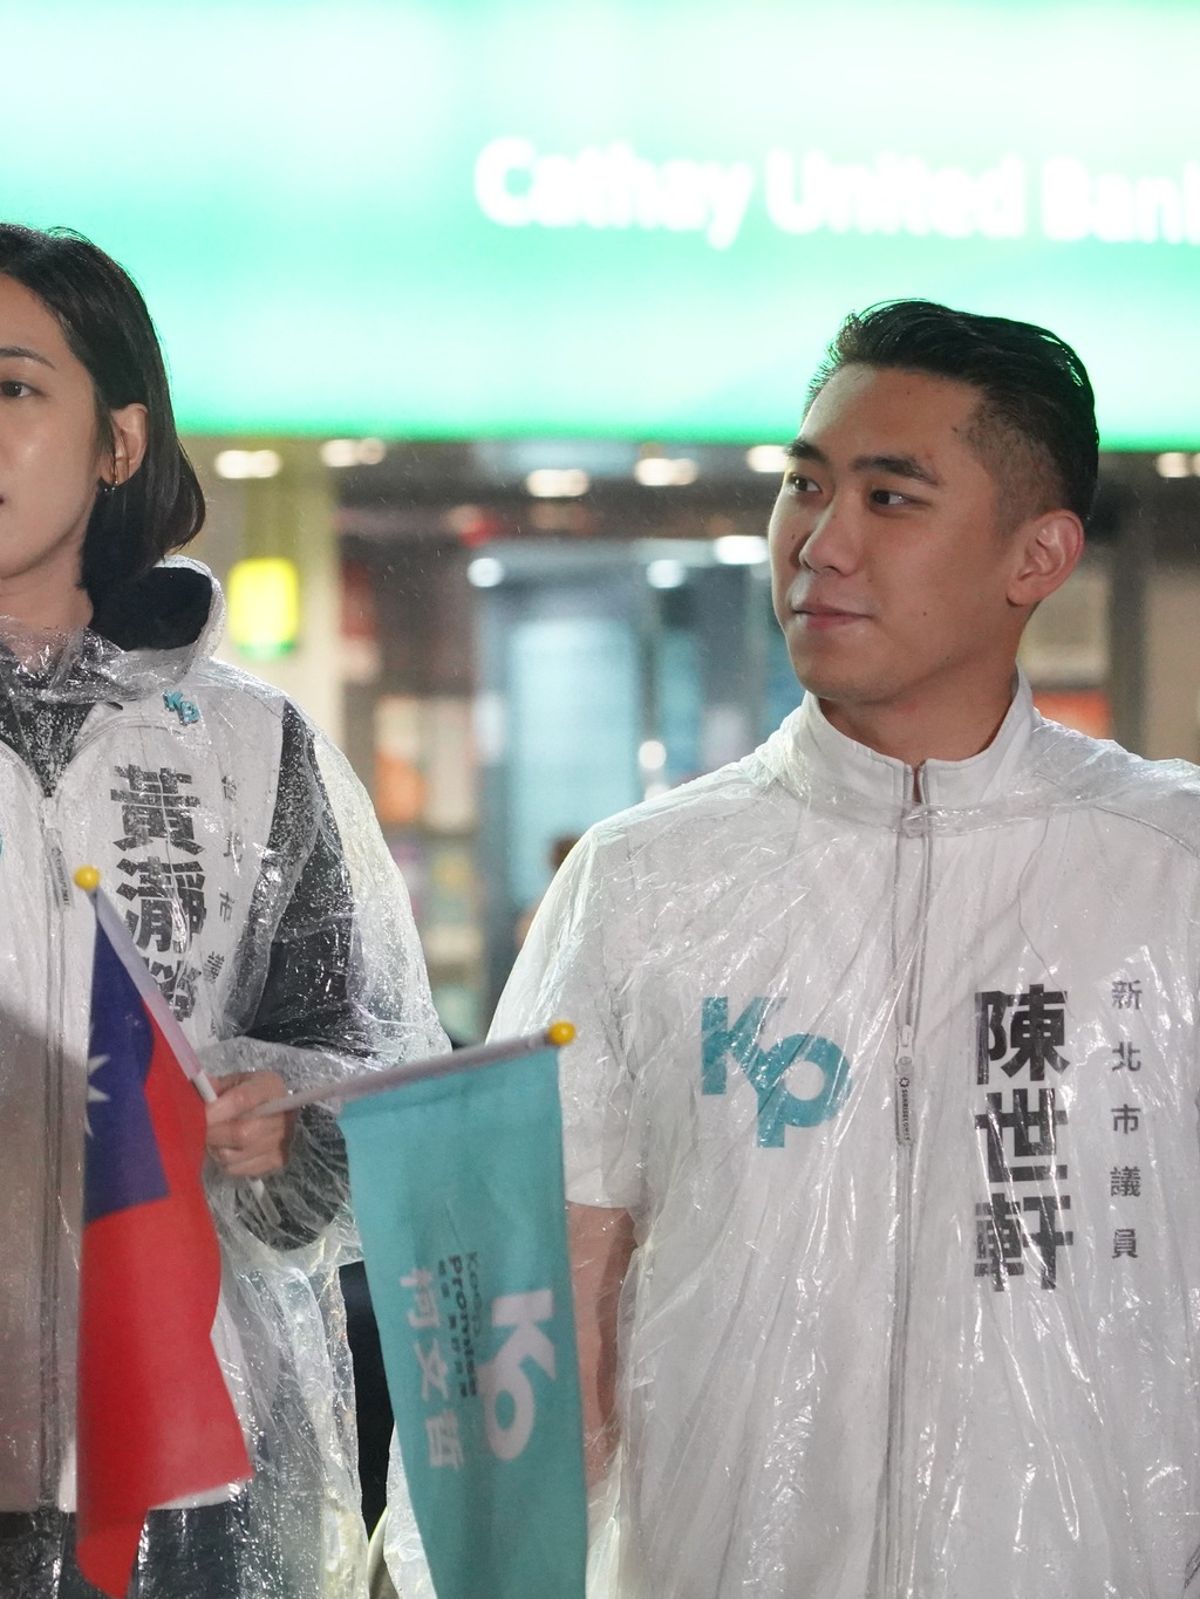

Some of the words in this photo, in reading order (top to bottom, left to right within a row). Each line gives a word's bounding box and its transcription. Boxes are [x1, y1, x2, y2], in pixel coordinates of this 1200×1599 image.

[474, 137, 755, 250] Cathay
[765, 147, 1027, 237] United
[701, 996, 853, 1148] KP
[973, 983, 1074, 1292] 陳世軒
[1110, 979, 1142, 1260] 新北市議員
[400, 1267, 465, 1471] 柯文哲
